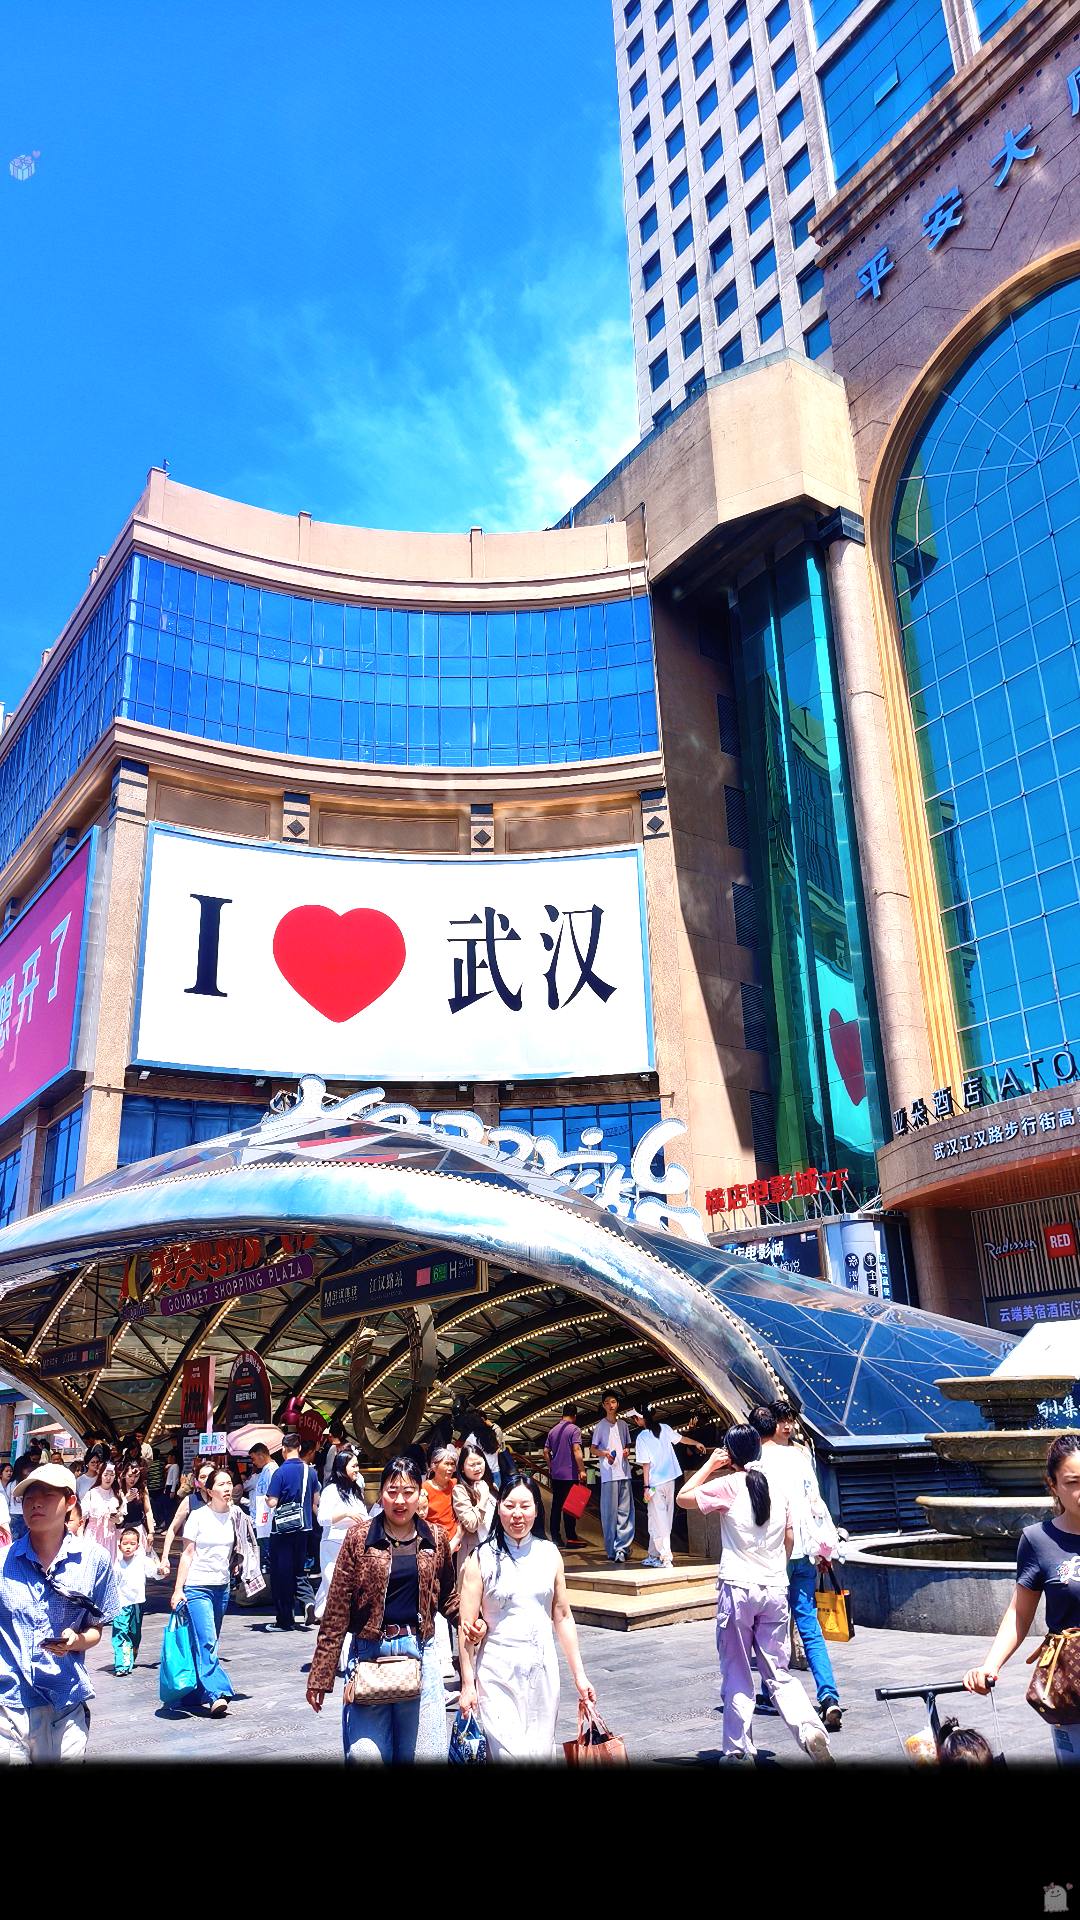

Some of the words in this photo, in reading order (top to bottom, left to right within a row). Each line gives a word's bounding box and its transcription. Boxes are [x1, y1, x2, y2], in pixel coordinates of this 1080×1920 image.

[184, 894, 232, 997] I
[447, 904, 617, 1015] 武汉
[893, 1076, 983, 1136] 亚朵酒店
[726, 1240, 784, 1262] 店电影城
[1050, 1233, 1071, 1249] RED
[168, 1288, 208, 1312] GOURMET
[214, 1273, 263, 1299] SHOPPING
[269, 1262, 303, 1284] PLAZA
[449, 1261, 457, 1280] H
